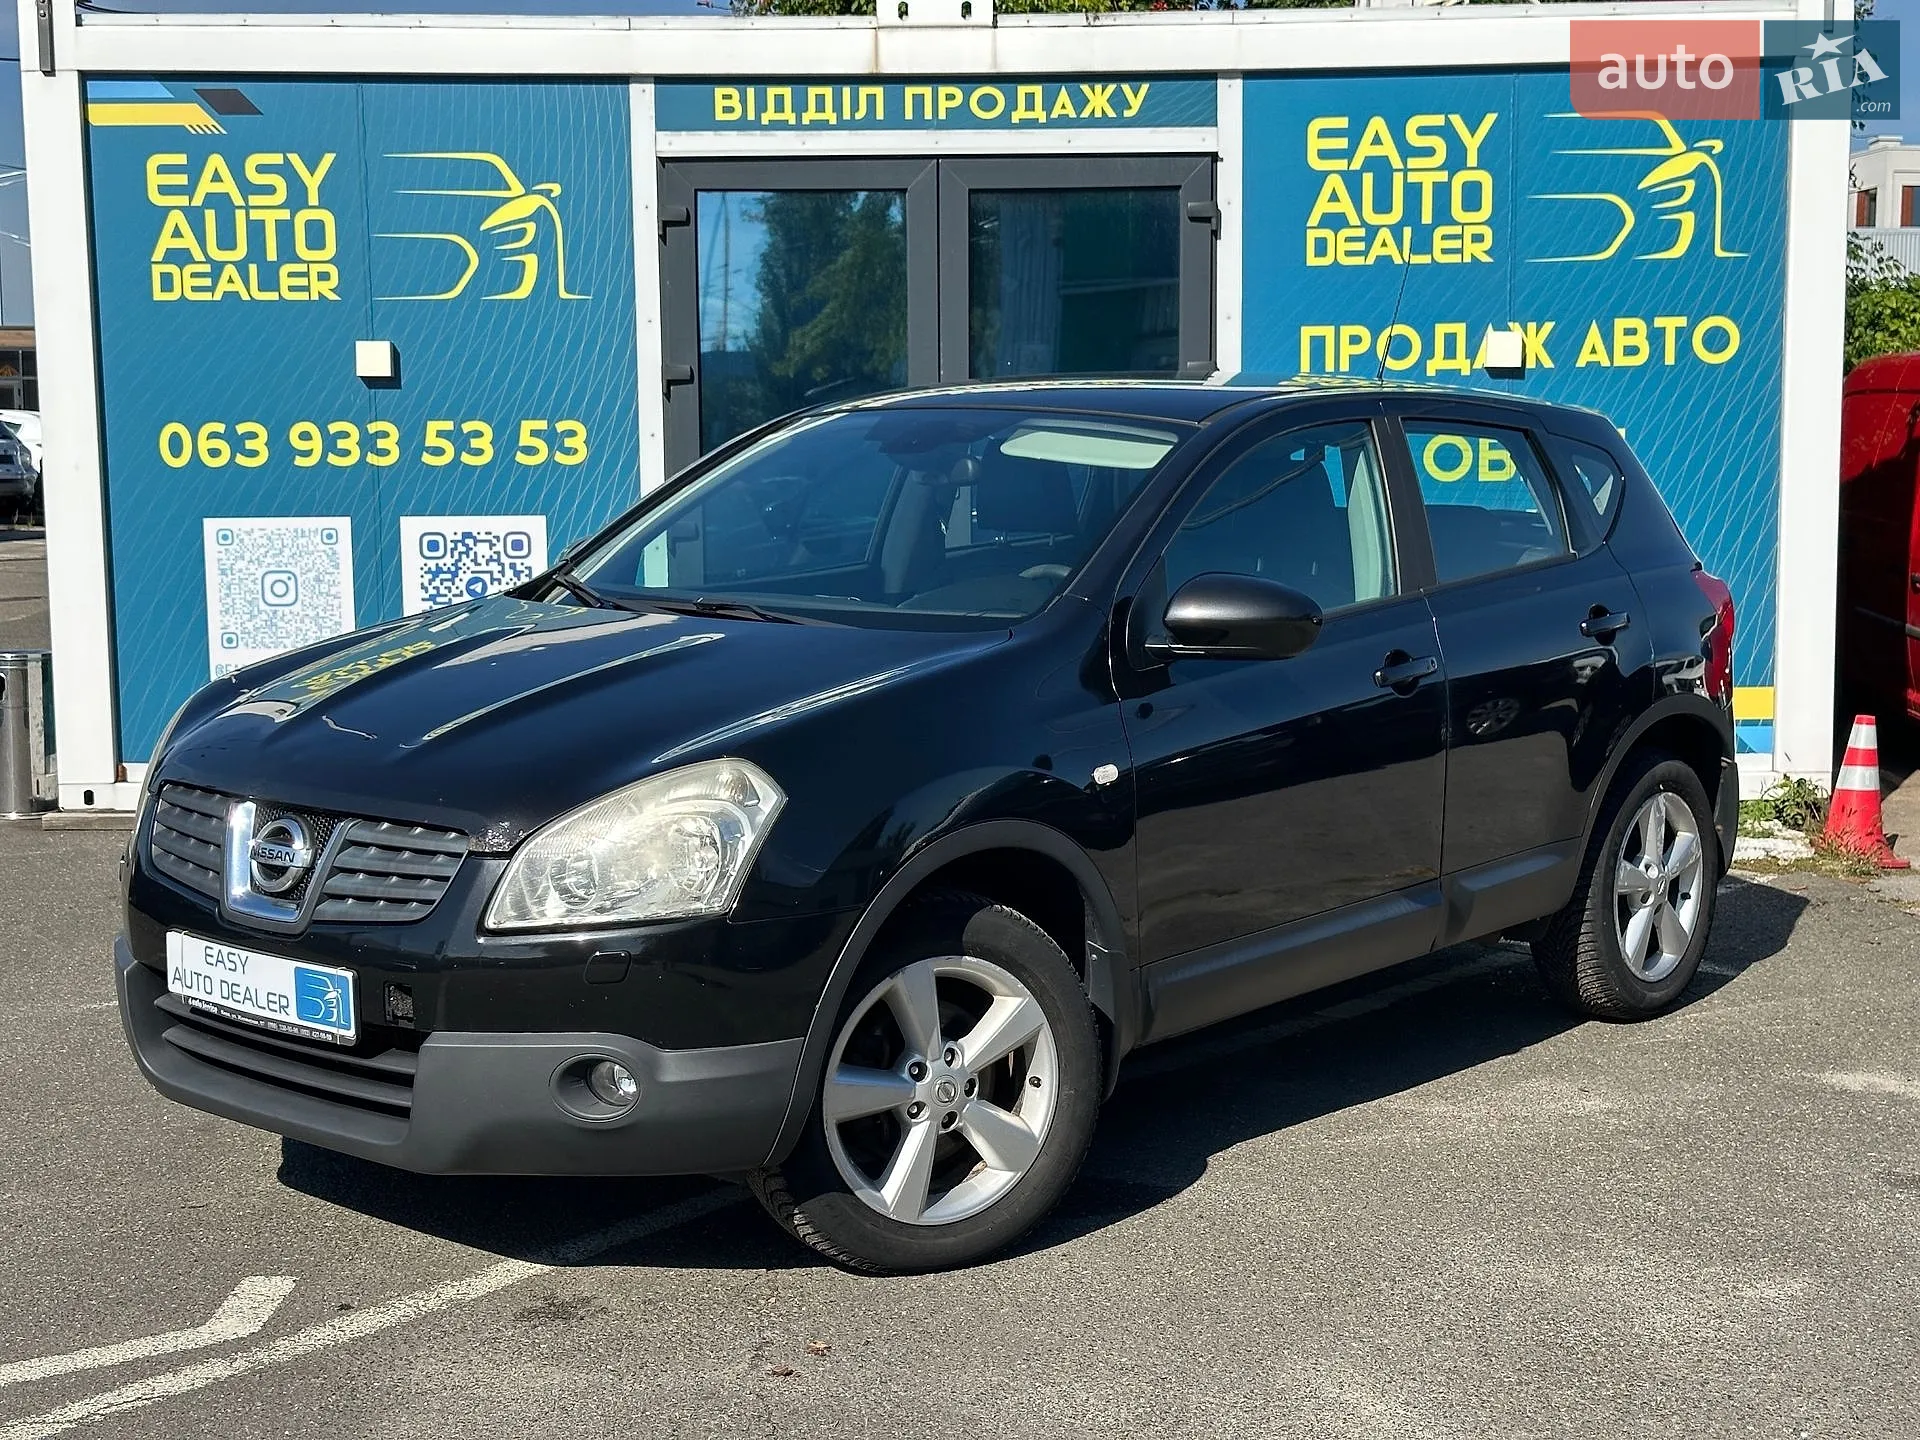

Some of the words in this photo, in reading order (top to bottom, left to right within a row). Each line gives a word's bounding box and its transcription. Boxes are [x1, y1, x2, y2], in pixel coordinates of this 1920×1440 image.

[713, 85, 885, 126] ВІДДІЛ
[903, 83, 1151, 124] ПРОДАЖУ
[1306, 112, 1498, 170] EASY
[146, 152, 336, 207] EASY
[1307, 170, 1494, 227] AUTO
[150, 208, 337, 262] AUTO
[1306, 225, 1494, 267] DEALER
[151, 263, 341, 302] DEALER
[1576, 316, 1741, 368] АВТО
[159, 422, 270, 468] 063
[288, 421, 400, 467] 933
[421, 420, 495, 467] 53
[515, 419, 589, 466] 53
[251, 846, 296, 863] NISSAN
[204, 945, 249, 975] EASY
[172, 966, 213, 995] AUTO
[220, 979, 290, 1016] DEALER
